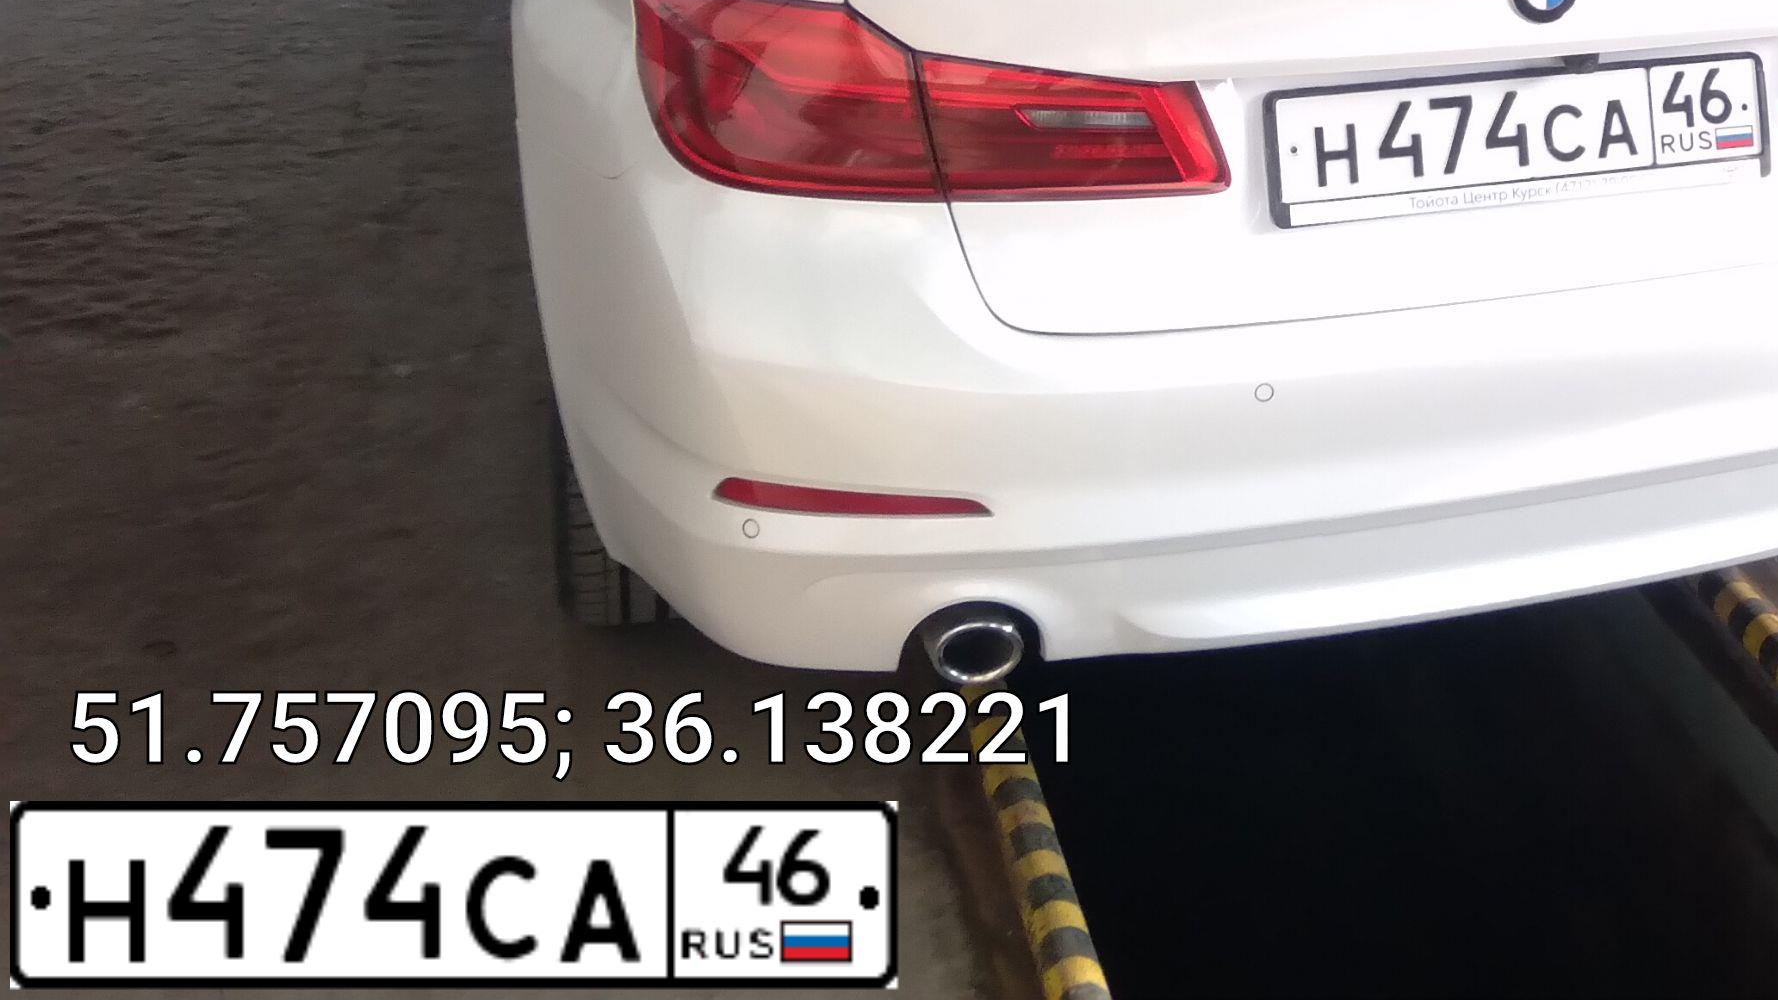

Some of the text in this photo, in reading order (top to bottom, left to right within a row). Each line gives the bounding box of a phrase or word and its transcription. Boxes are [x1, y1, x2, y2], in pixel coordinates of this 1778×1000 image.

[1662, 68, 1733, 128] 46
[1660, 131, 1713, 154] RUS
[1409, 194, 1459, 210] Тойота
[1463, 190, 1508, 207] Центр
[1512, 184, 1552, 201] Курск
